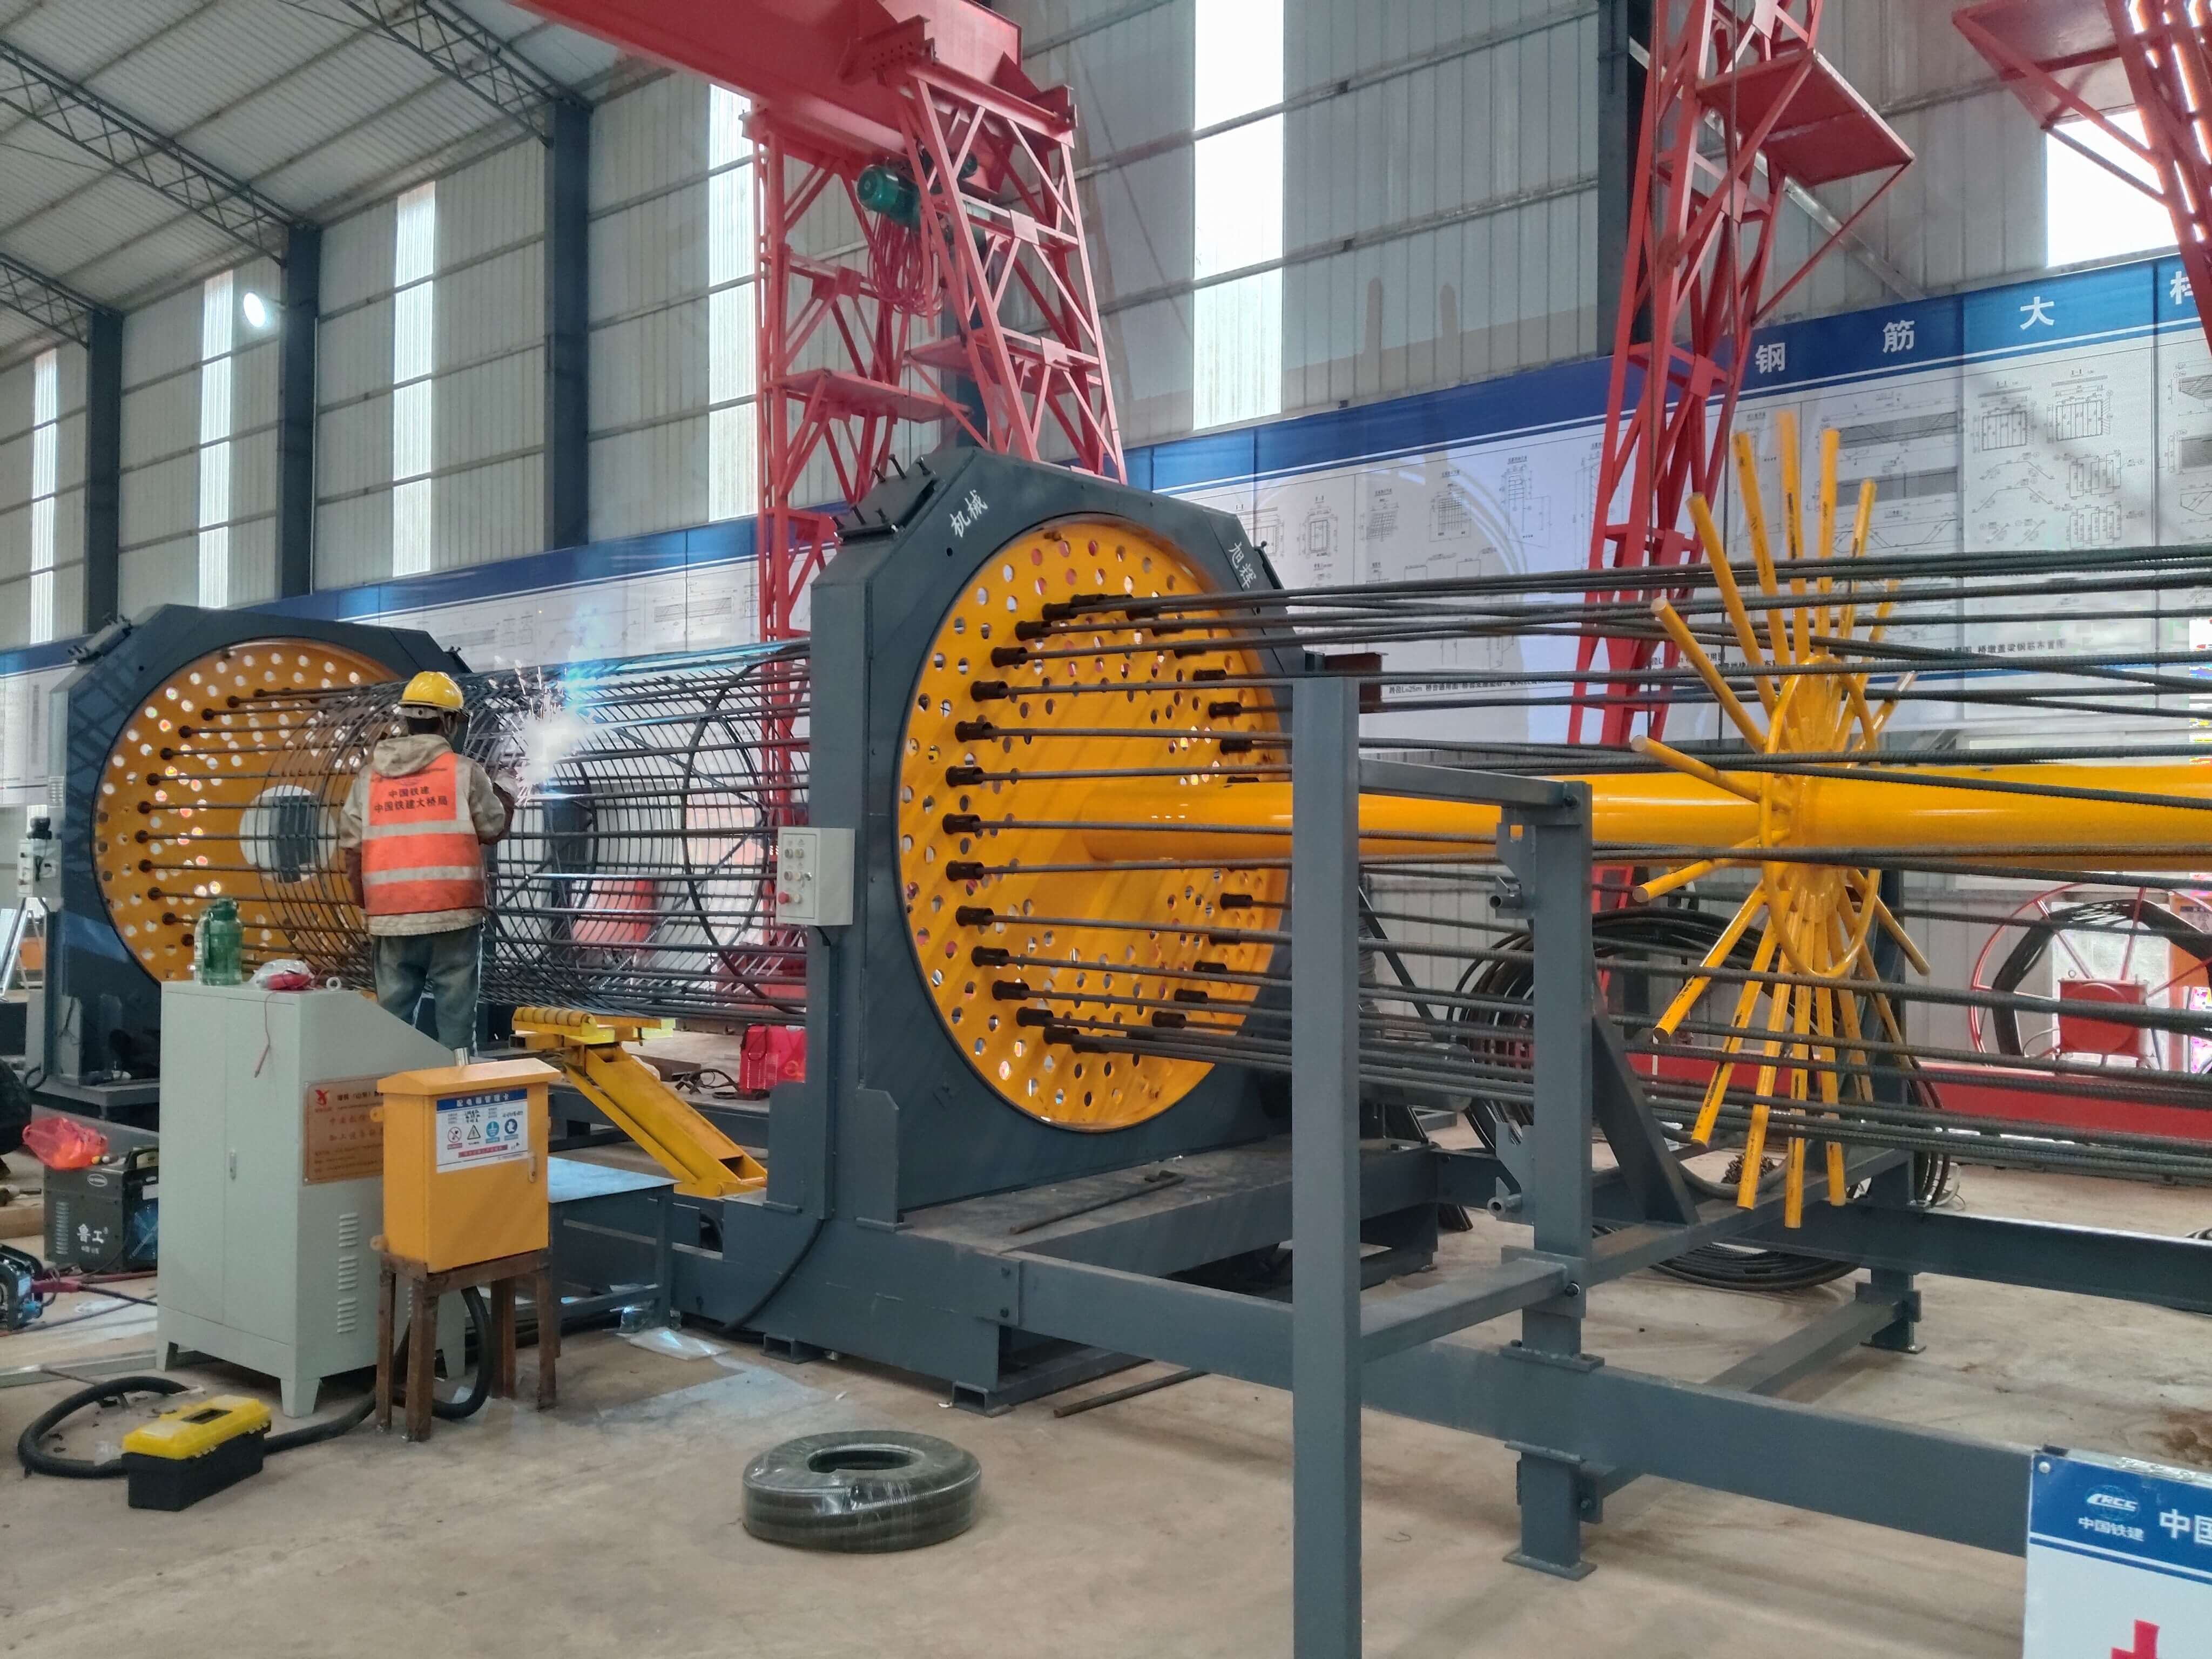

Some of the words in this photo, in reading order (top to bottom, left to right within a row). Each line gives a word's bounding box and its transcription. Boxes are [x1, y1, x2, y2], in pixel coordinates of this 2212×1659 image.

[949, 489, 988, 537] 机械
[388, 786, 430, 798] 中国铁建
[374, 795, 448, 813] 中国铁建大桥局
[77, 1223, 104, 1244] 鲁工
[2078, 1516, 2145, 1542] 中国铁建
